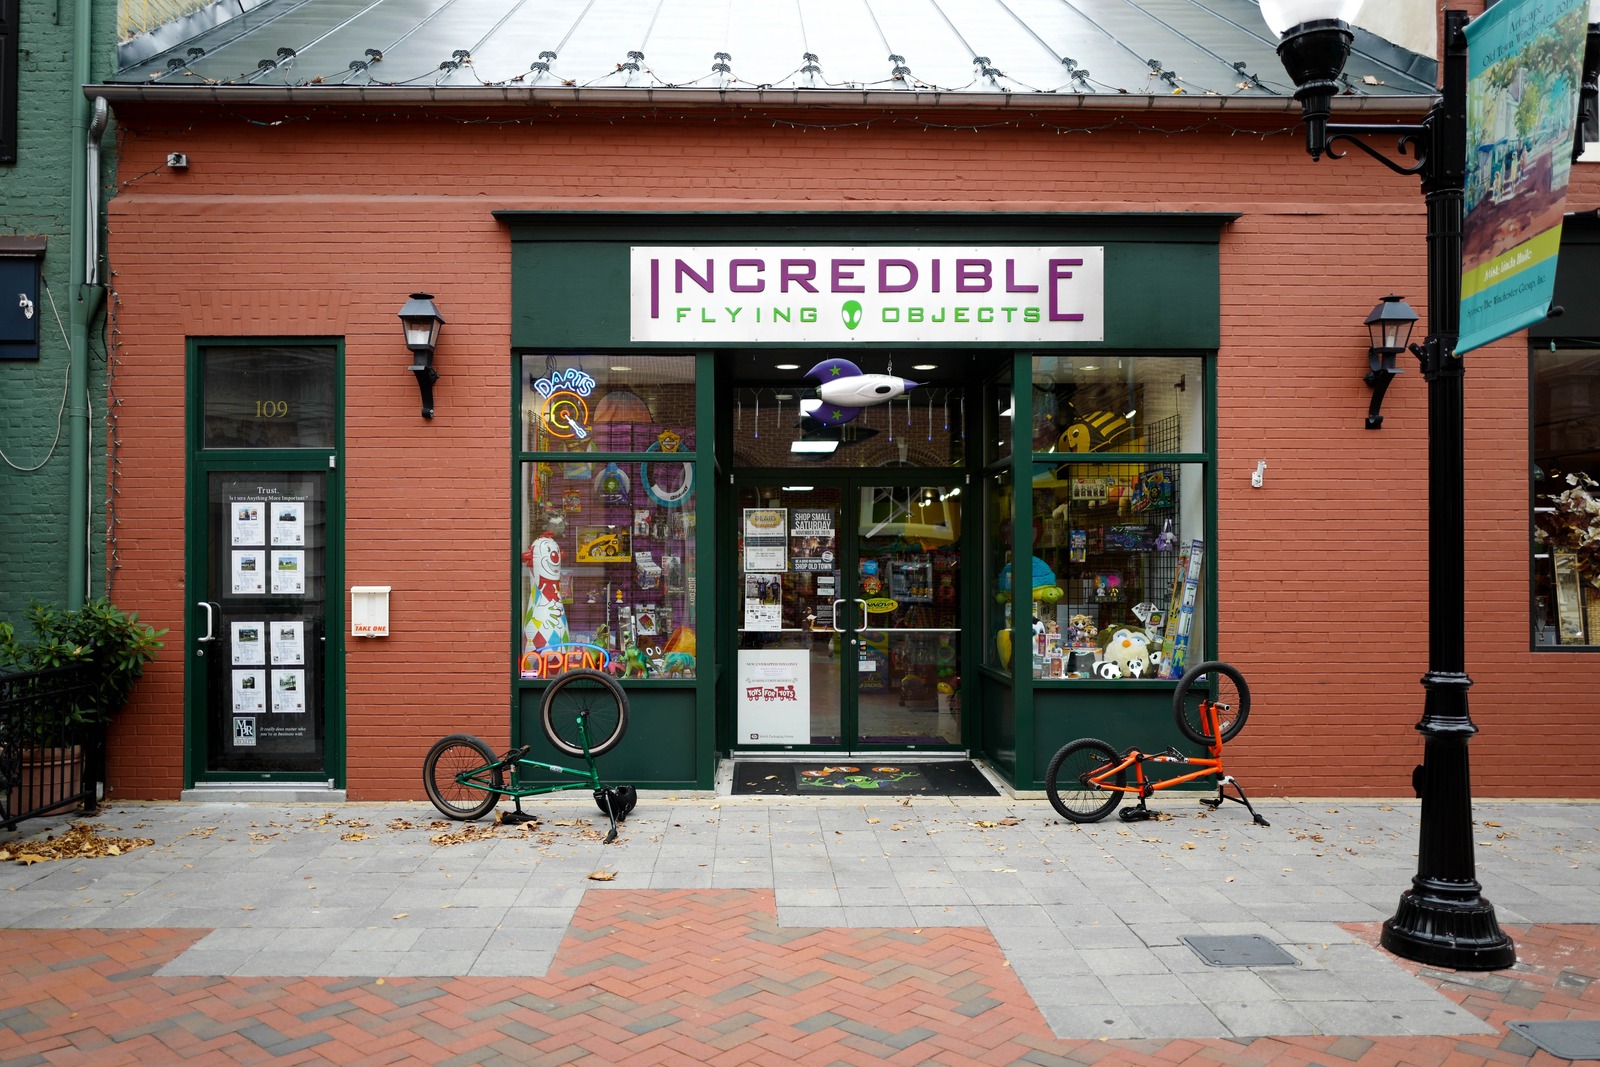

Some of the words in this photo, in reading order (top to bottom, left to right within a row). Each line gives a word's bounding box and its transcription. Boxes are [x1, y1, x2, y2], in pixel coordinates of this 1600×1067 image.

[1509, 4, 1544, 34] Artscape
[1482, 53, 1496, 67] Old
[1496, 41, 1514, 59] Town
[1515, 11, 1555, 42] Winchester
[651, 258, 1084, 321] INCREDIBLE
[676, 306, 818, 323] FLYING
[882, 306, 1041, 323] OBJECTS
[534, 368, 595, 400] DARTS
[254, 400, 288, 418] 109
[257, 486, 280, 494] Trust.
[795, 521, 832, 530] SATURDAY
[521, 651, 604, 679] OPEN
[764, 689, 776, 697] FOR
[780, 690, 794, 698] TOTS
